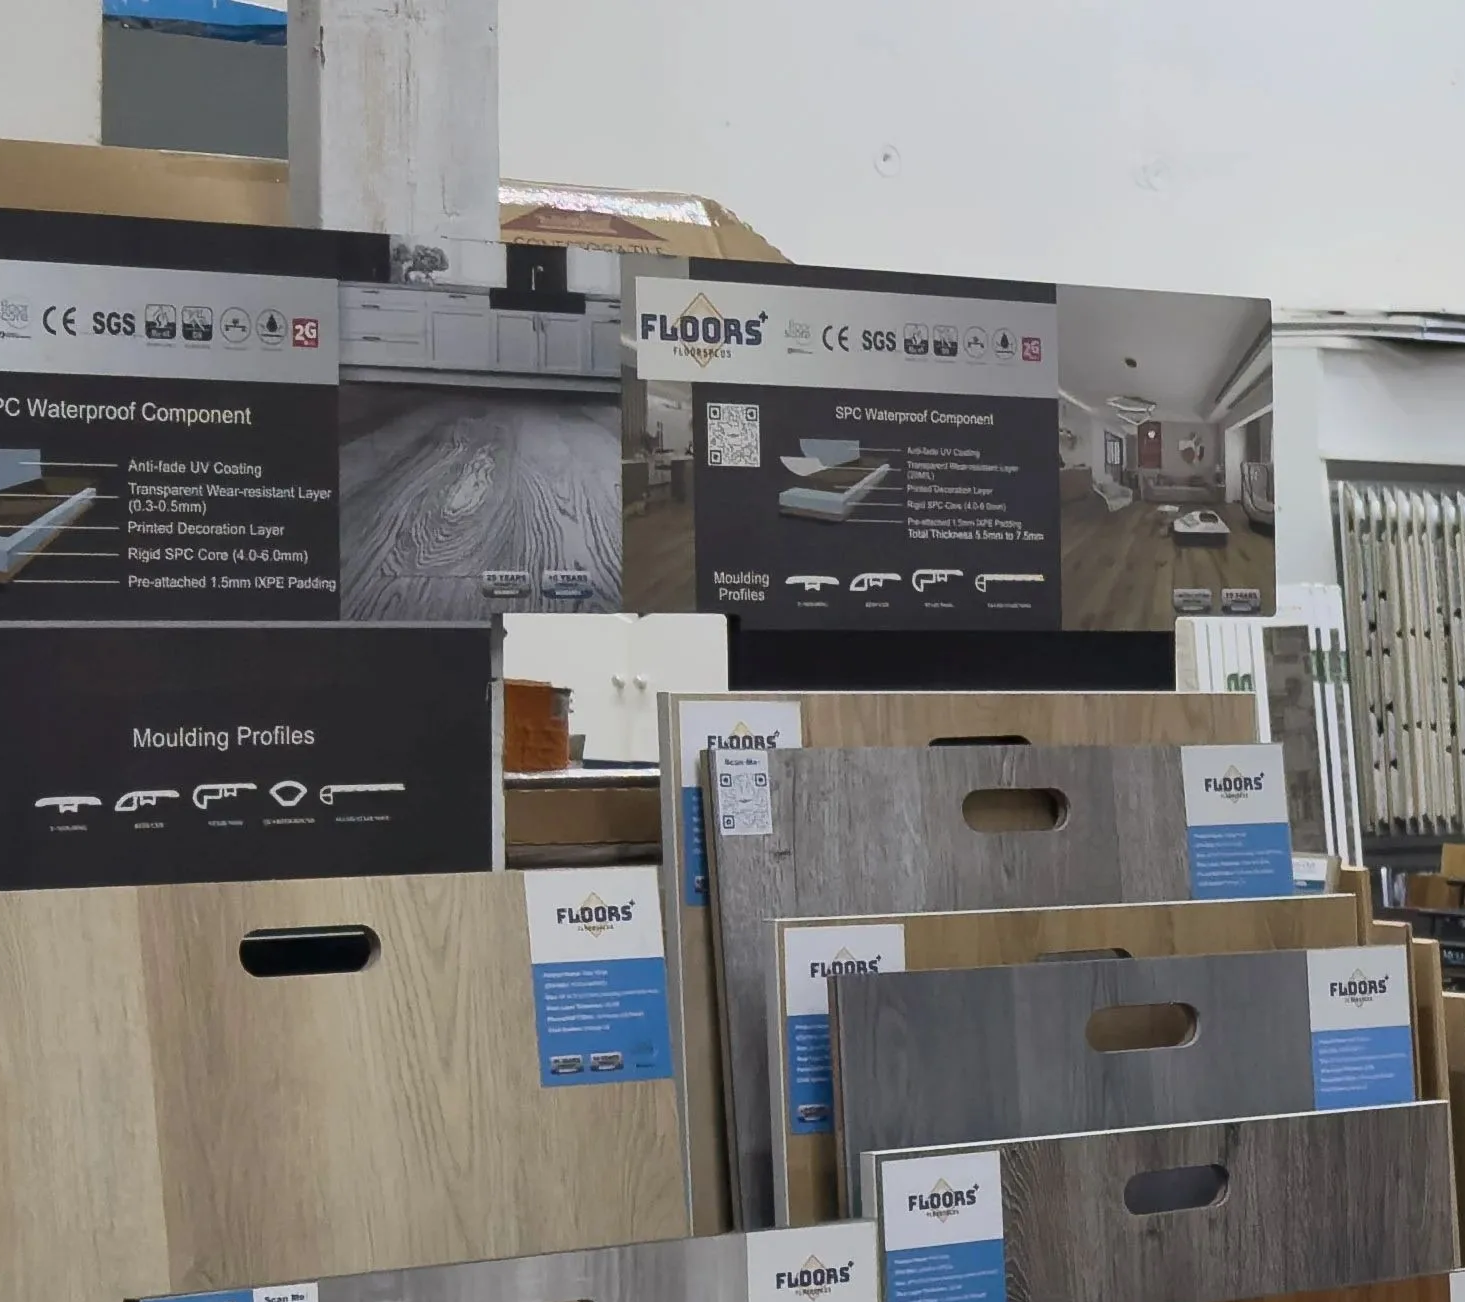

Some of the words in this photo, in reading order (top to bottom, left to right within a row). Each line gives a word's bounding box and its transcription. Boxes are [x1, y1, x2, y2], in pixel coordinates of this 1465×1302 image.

[93, 311, 136, 336] SGS
[862, 330, 897, 352] SGS
[27, 398, 136, 424] Waterproof
[141, 403, 252, 427] Component
[836, 405, 861, 420] SPC
[865, 406, 928, 425] Waterproof
[931, 410, 994, 428] Component
[128, 460, 186, 475] Anti-fade
[190, 462, 209, 475] UV
[213, 463, 262, 478] Coating
[128, 482, 203, 499] Transparent
[207, 485, 294, 500] Wear-resistant
[298, 486, 332, 502] Layer
[128, 522, 173, 536] Printed
[176, 523, 247, 537] Decoration
[250, 523, 285, 538] Layer
[128, 547, 160, 563] Rigid
[164, 548, 194, 562] SPC
[197, 549, 229, 562] Core
[128, 574, 207, 589] Pre-attached
[211, 575, 251, 589] 1.5mm
[288, 577, 336, 592] Padding
[713, 570, 769, 588] Moulding
[719, 586, 764, 602] Profiles
[133, 726, 229, 752] Moulding
[237, 725, 315, 747] Profiles
